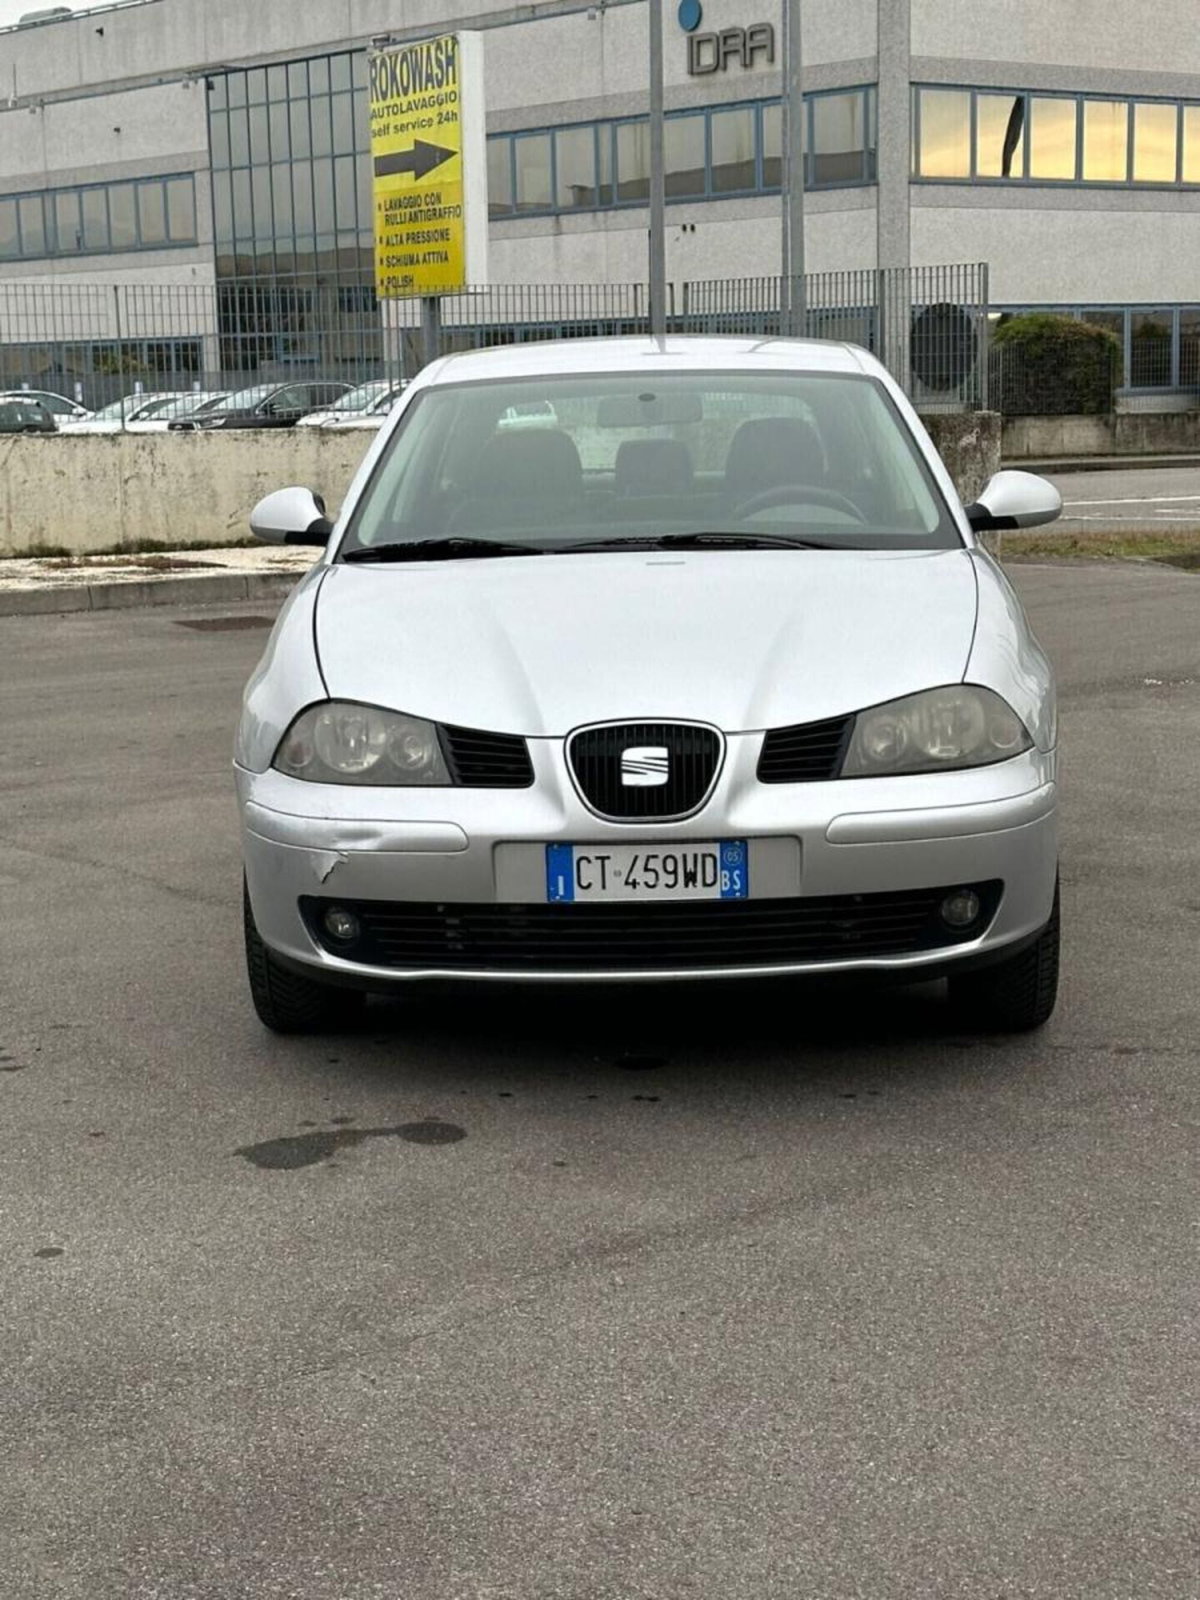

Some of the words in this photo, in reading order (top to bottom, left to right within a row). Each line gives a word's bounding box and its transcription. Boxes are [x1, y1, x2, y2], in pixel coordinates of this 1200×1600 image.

[687, 22, 775, 76] IDRA
[369, 37, 457, 102] ROKOWASH
[370, 90, 457, 119] AUTOLAVAGGIO
[372, 123, 390, 138] self
[393, 117, 433, 132] service
[437, 110, 458, 125] 24h
[384, 194, 422, 212] LAVAGGIO
[424, 191, 442, 206] CON
[384, 211, 407, 226] RULLI
[408, 204, 461, 223] ANTIGRAFFIO
[385, 233, 404, 246] ALTA
[406, 228, 450, 244] PRESSIONE
[386, 253, 420, 268] SCHIUMA
[422, 250, 449, 265] ATTIVA
[387, 274, 414, 288] POLISH
